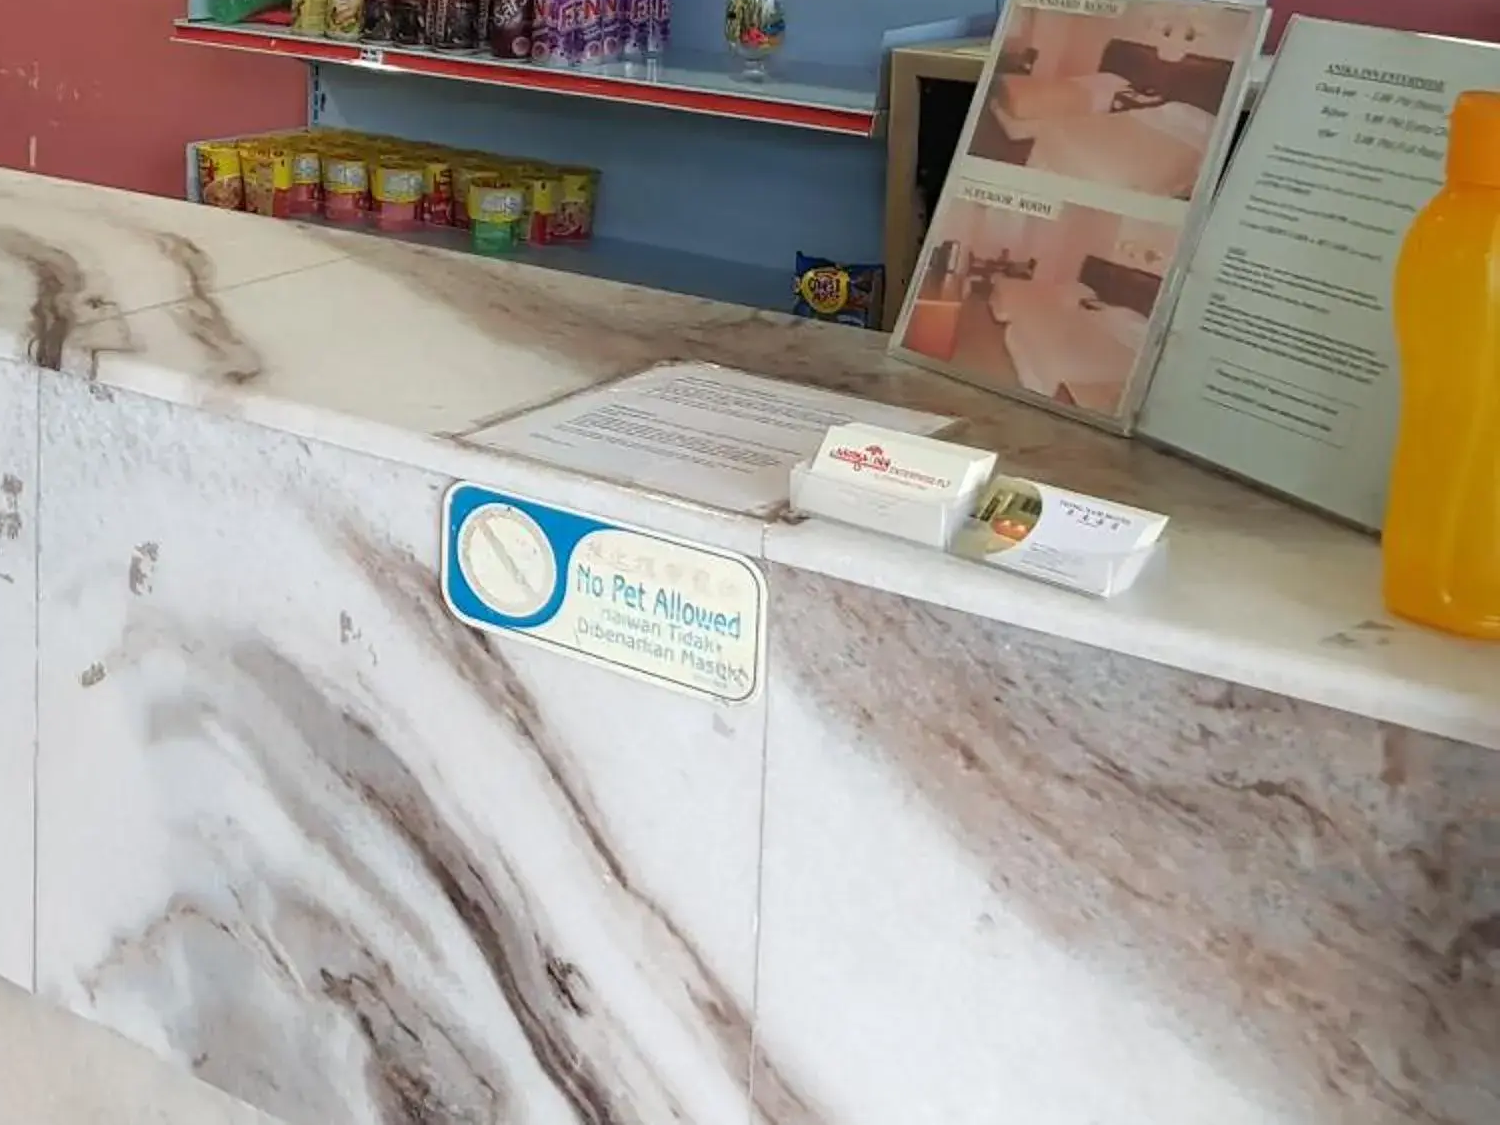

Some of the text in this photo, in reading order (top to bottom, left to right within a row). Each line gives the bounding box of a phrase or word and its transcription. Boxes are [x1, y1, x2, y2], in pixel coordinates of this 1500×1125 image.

[576, 562, 741, 641] No Pet Allowed
